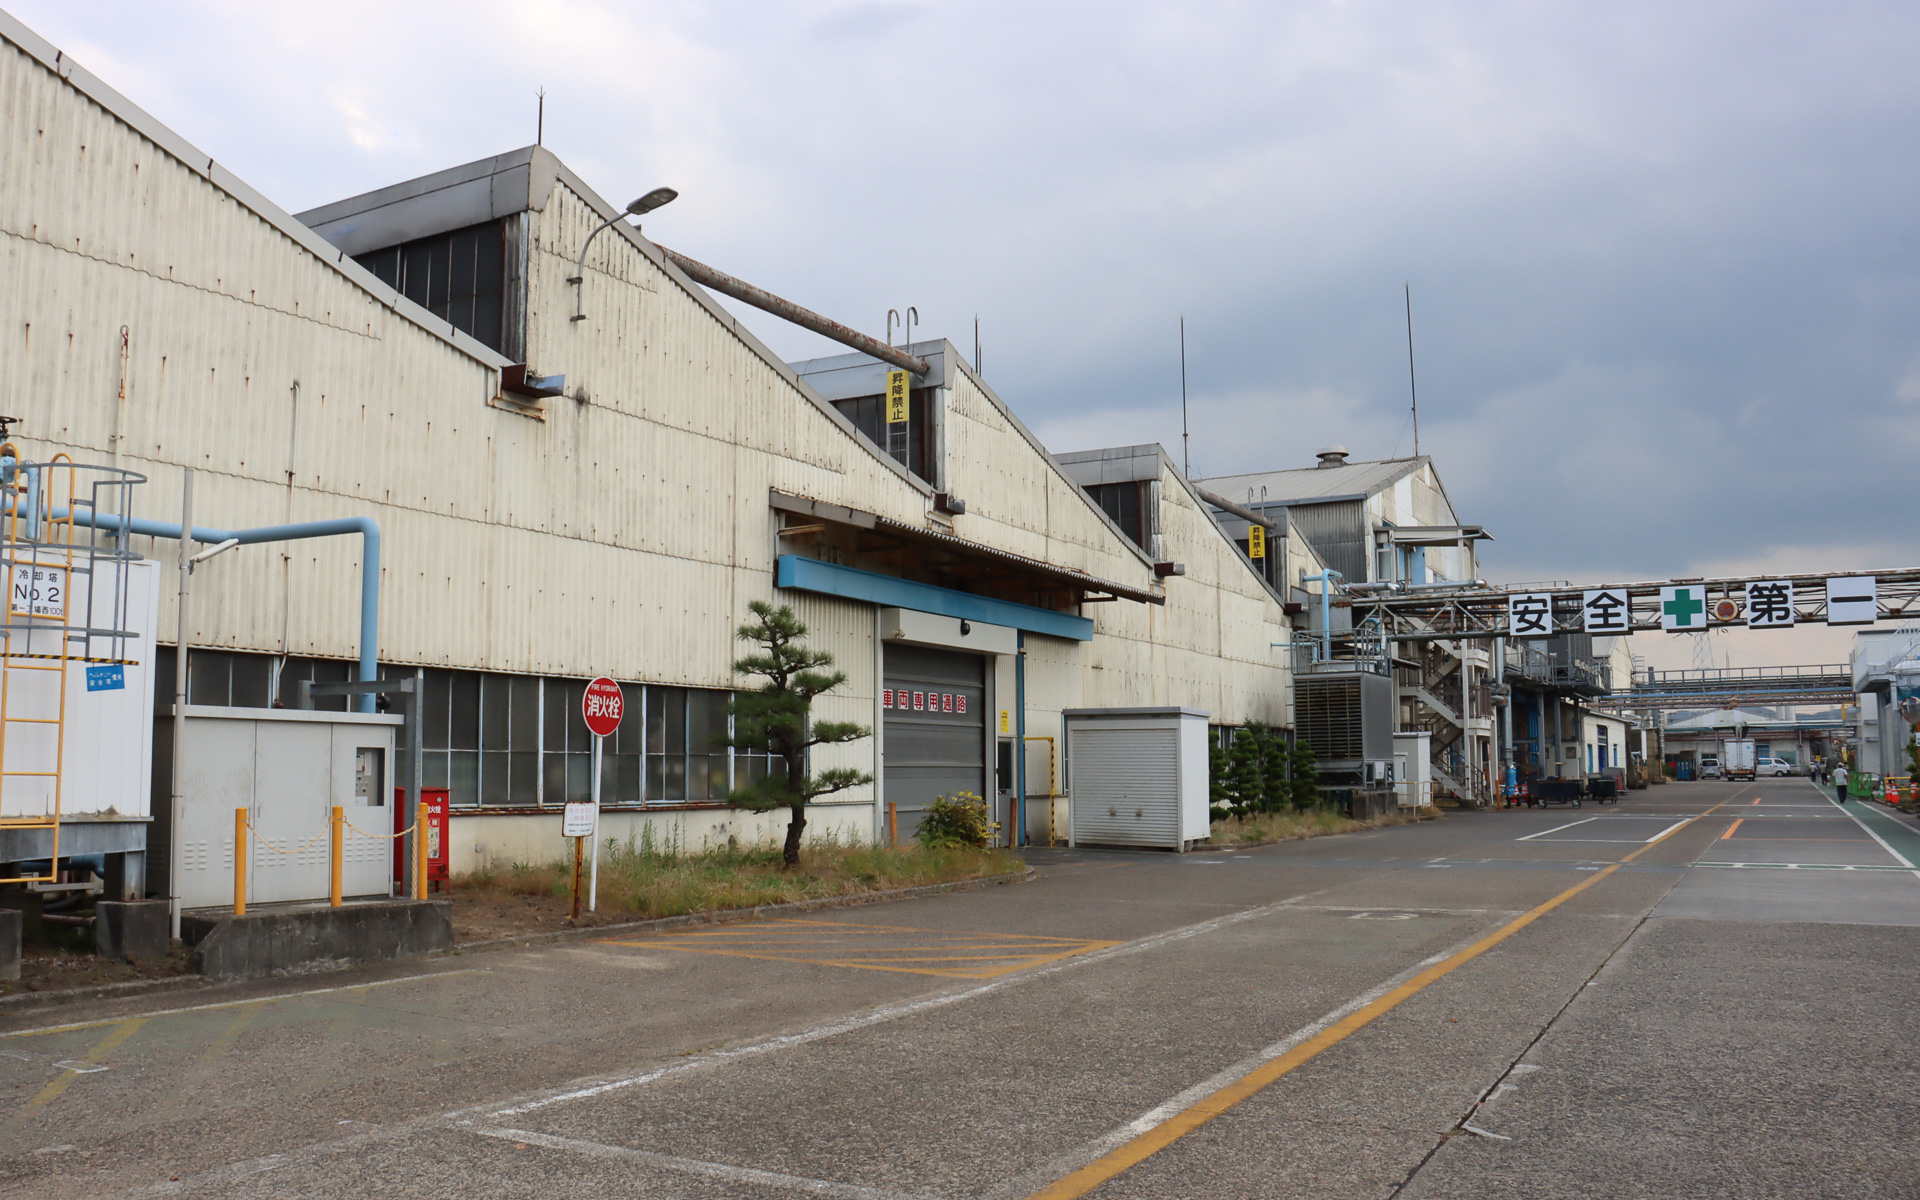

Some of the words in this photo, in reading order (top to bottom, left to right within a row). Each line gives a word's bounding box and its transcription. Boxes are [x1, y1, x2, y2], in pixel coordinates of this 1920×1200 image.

[892, 373, 903, 420] 昇降禁止
[19, 569, 58, 582] 冷却塔
[601, 684, 618, 692] HYDRANT
[587, 694, 621, 718] 消火栓
[883, 689, 966, 713] 車両専用通路
